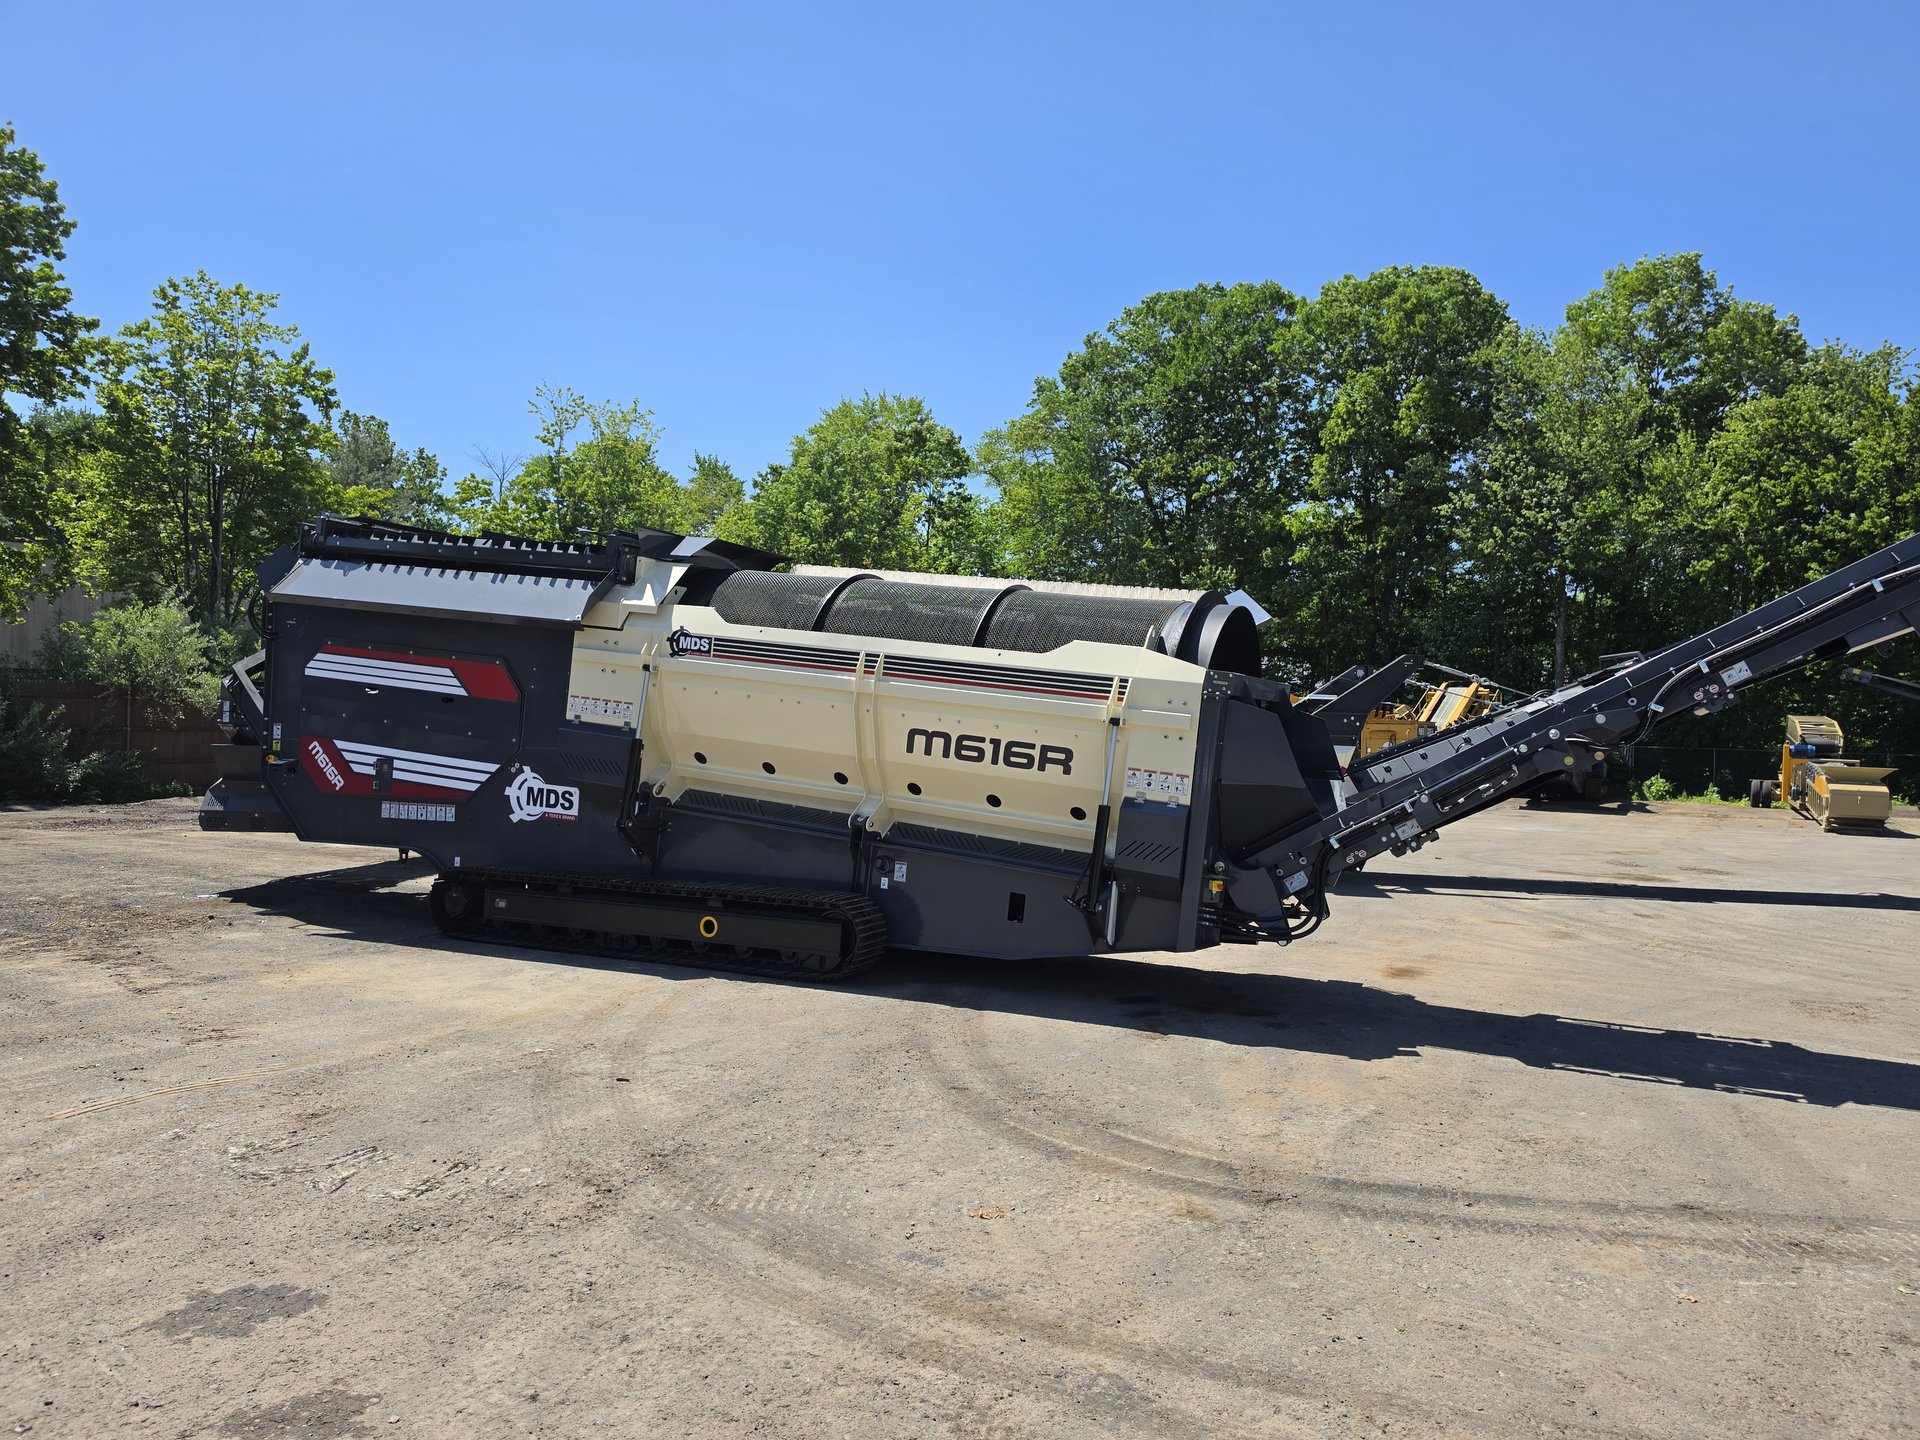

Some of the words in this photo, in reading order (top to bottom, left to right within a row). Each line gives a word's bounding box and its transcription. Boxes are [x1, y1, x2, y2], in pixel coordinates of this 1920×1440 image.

[679, 636, 710, 651] MDS
[308, 740, 345, 791] M616R
[906, 728, 1074, 776] M616R
[526, 786, 574, 811] MDS
